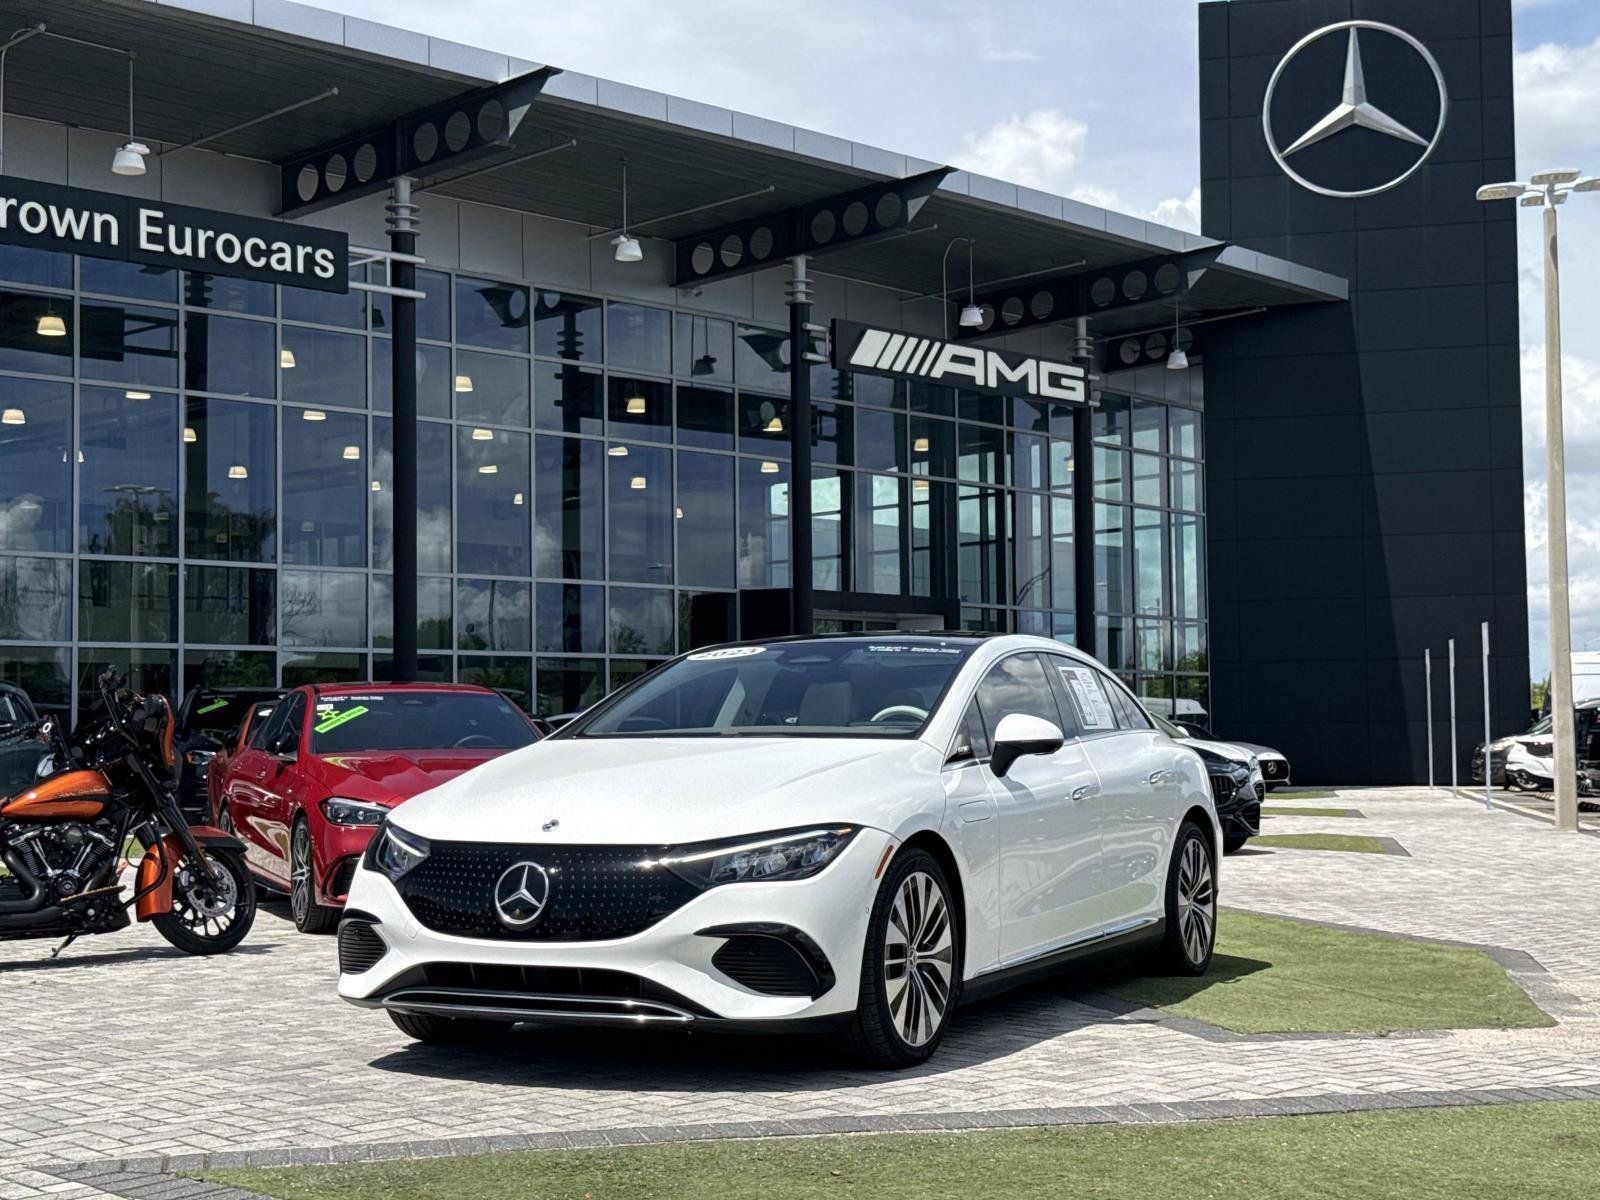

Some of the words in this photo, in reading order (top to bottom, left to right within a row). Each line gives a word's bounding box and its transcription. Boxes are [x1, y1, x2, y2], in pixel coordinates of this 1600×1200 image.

[0, 196, 119, 246] rown
[139, 208, 336, 279] Eurocars
[930, 343, 1085, 403] AMG
